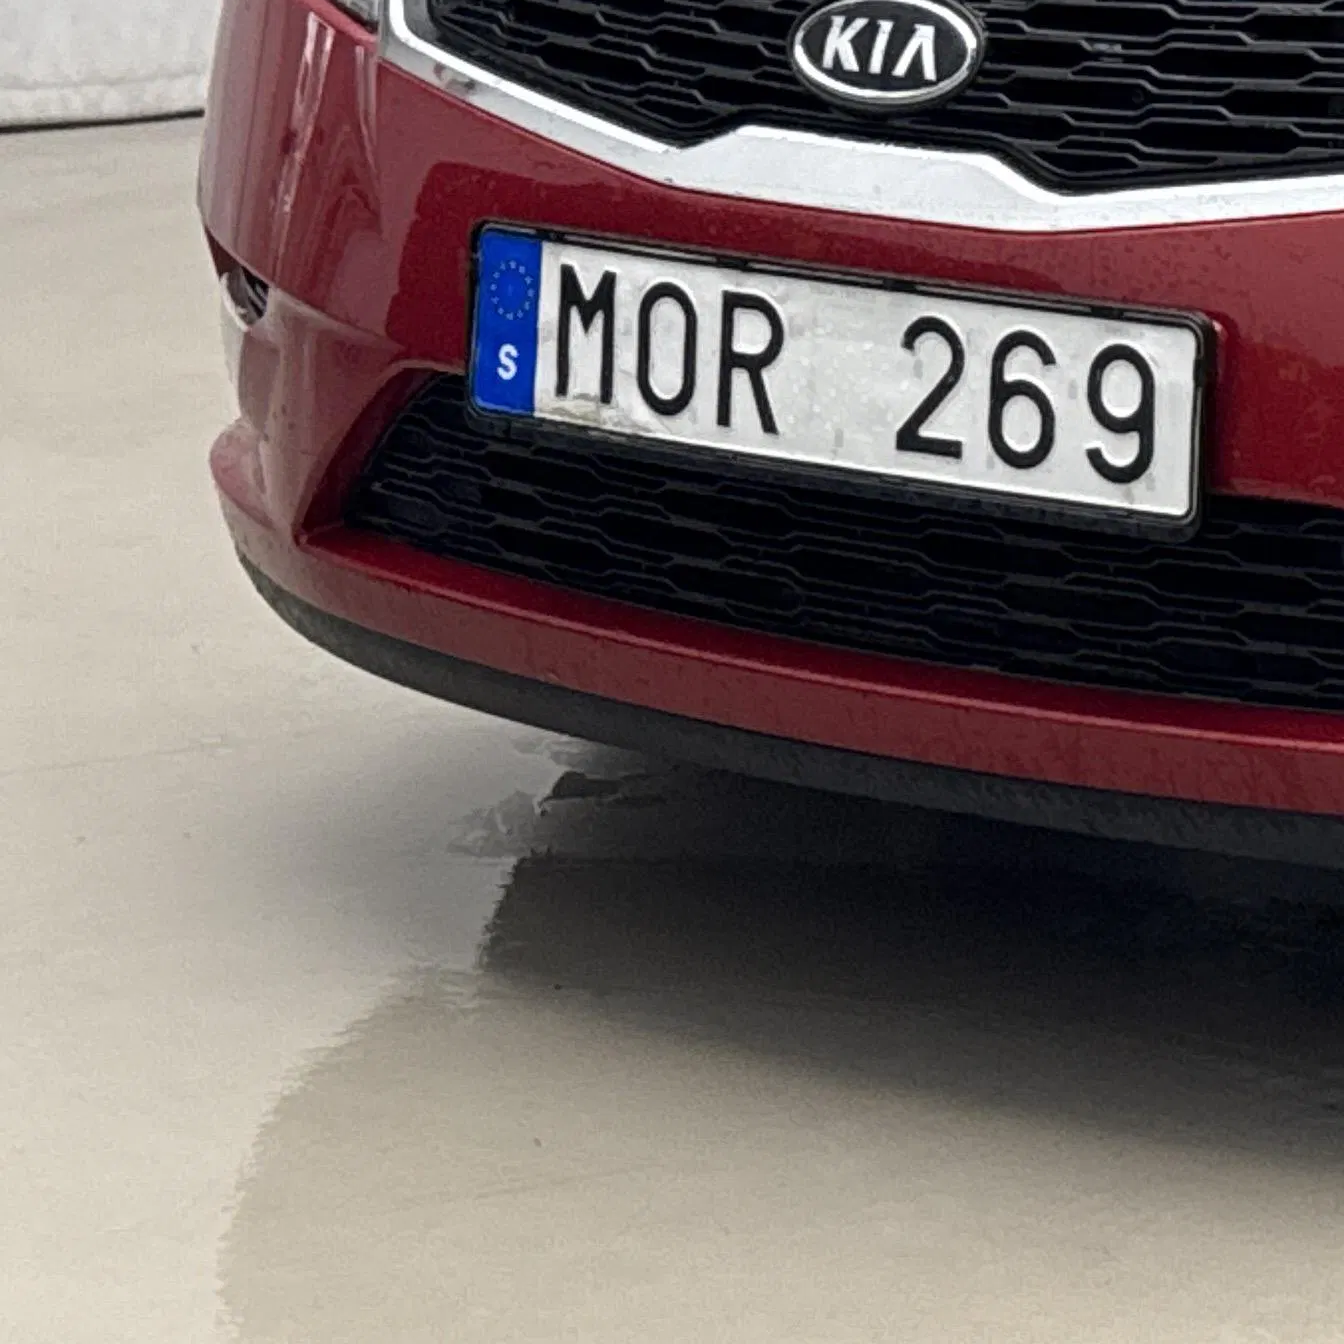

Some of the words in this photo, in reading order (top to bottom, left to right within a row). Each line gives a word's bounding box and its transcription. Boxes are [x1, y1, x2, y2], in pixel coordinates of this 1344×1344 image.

[822, 15, 937, 82] KIA
[496, 343, 520, 380] S
[555, 263, 785, 435] MOR
[895, 315, 1156, 484] 269
